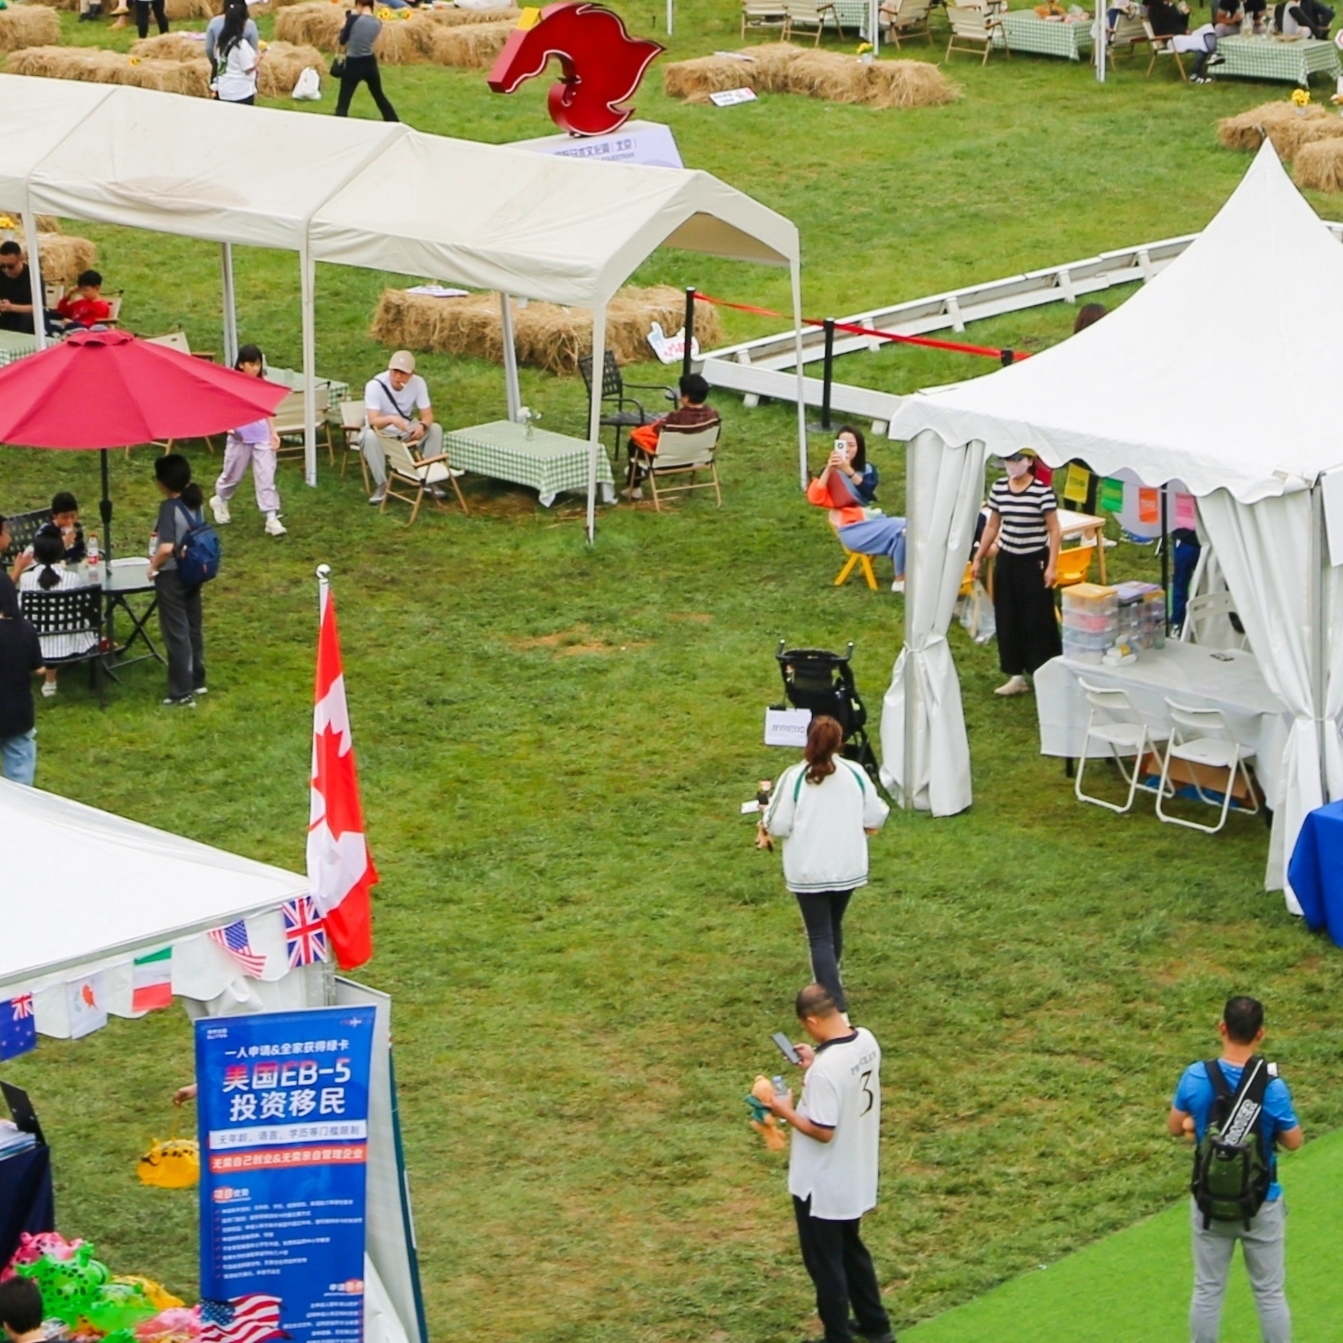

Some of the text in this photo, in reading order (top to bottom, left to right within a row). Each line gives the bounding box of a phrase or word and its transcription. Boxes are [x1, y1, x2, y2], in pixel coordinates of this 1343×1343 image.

[224, 1039, 349, 1058] 一人申请&全家获得绿卡
[222, 1057, 351, 1093] 美国EB-5
[229, 1087, 346, 1122] 投资移民
[860, 1069, 874, 1118] 3
[218, 1125, 360, 1145] 无年龄、语言、学历等门槛限制
